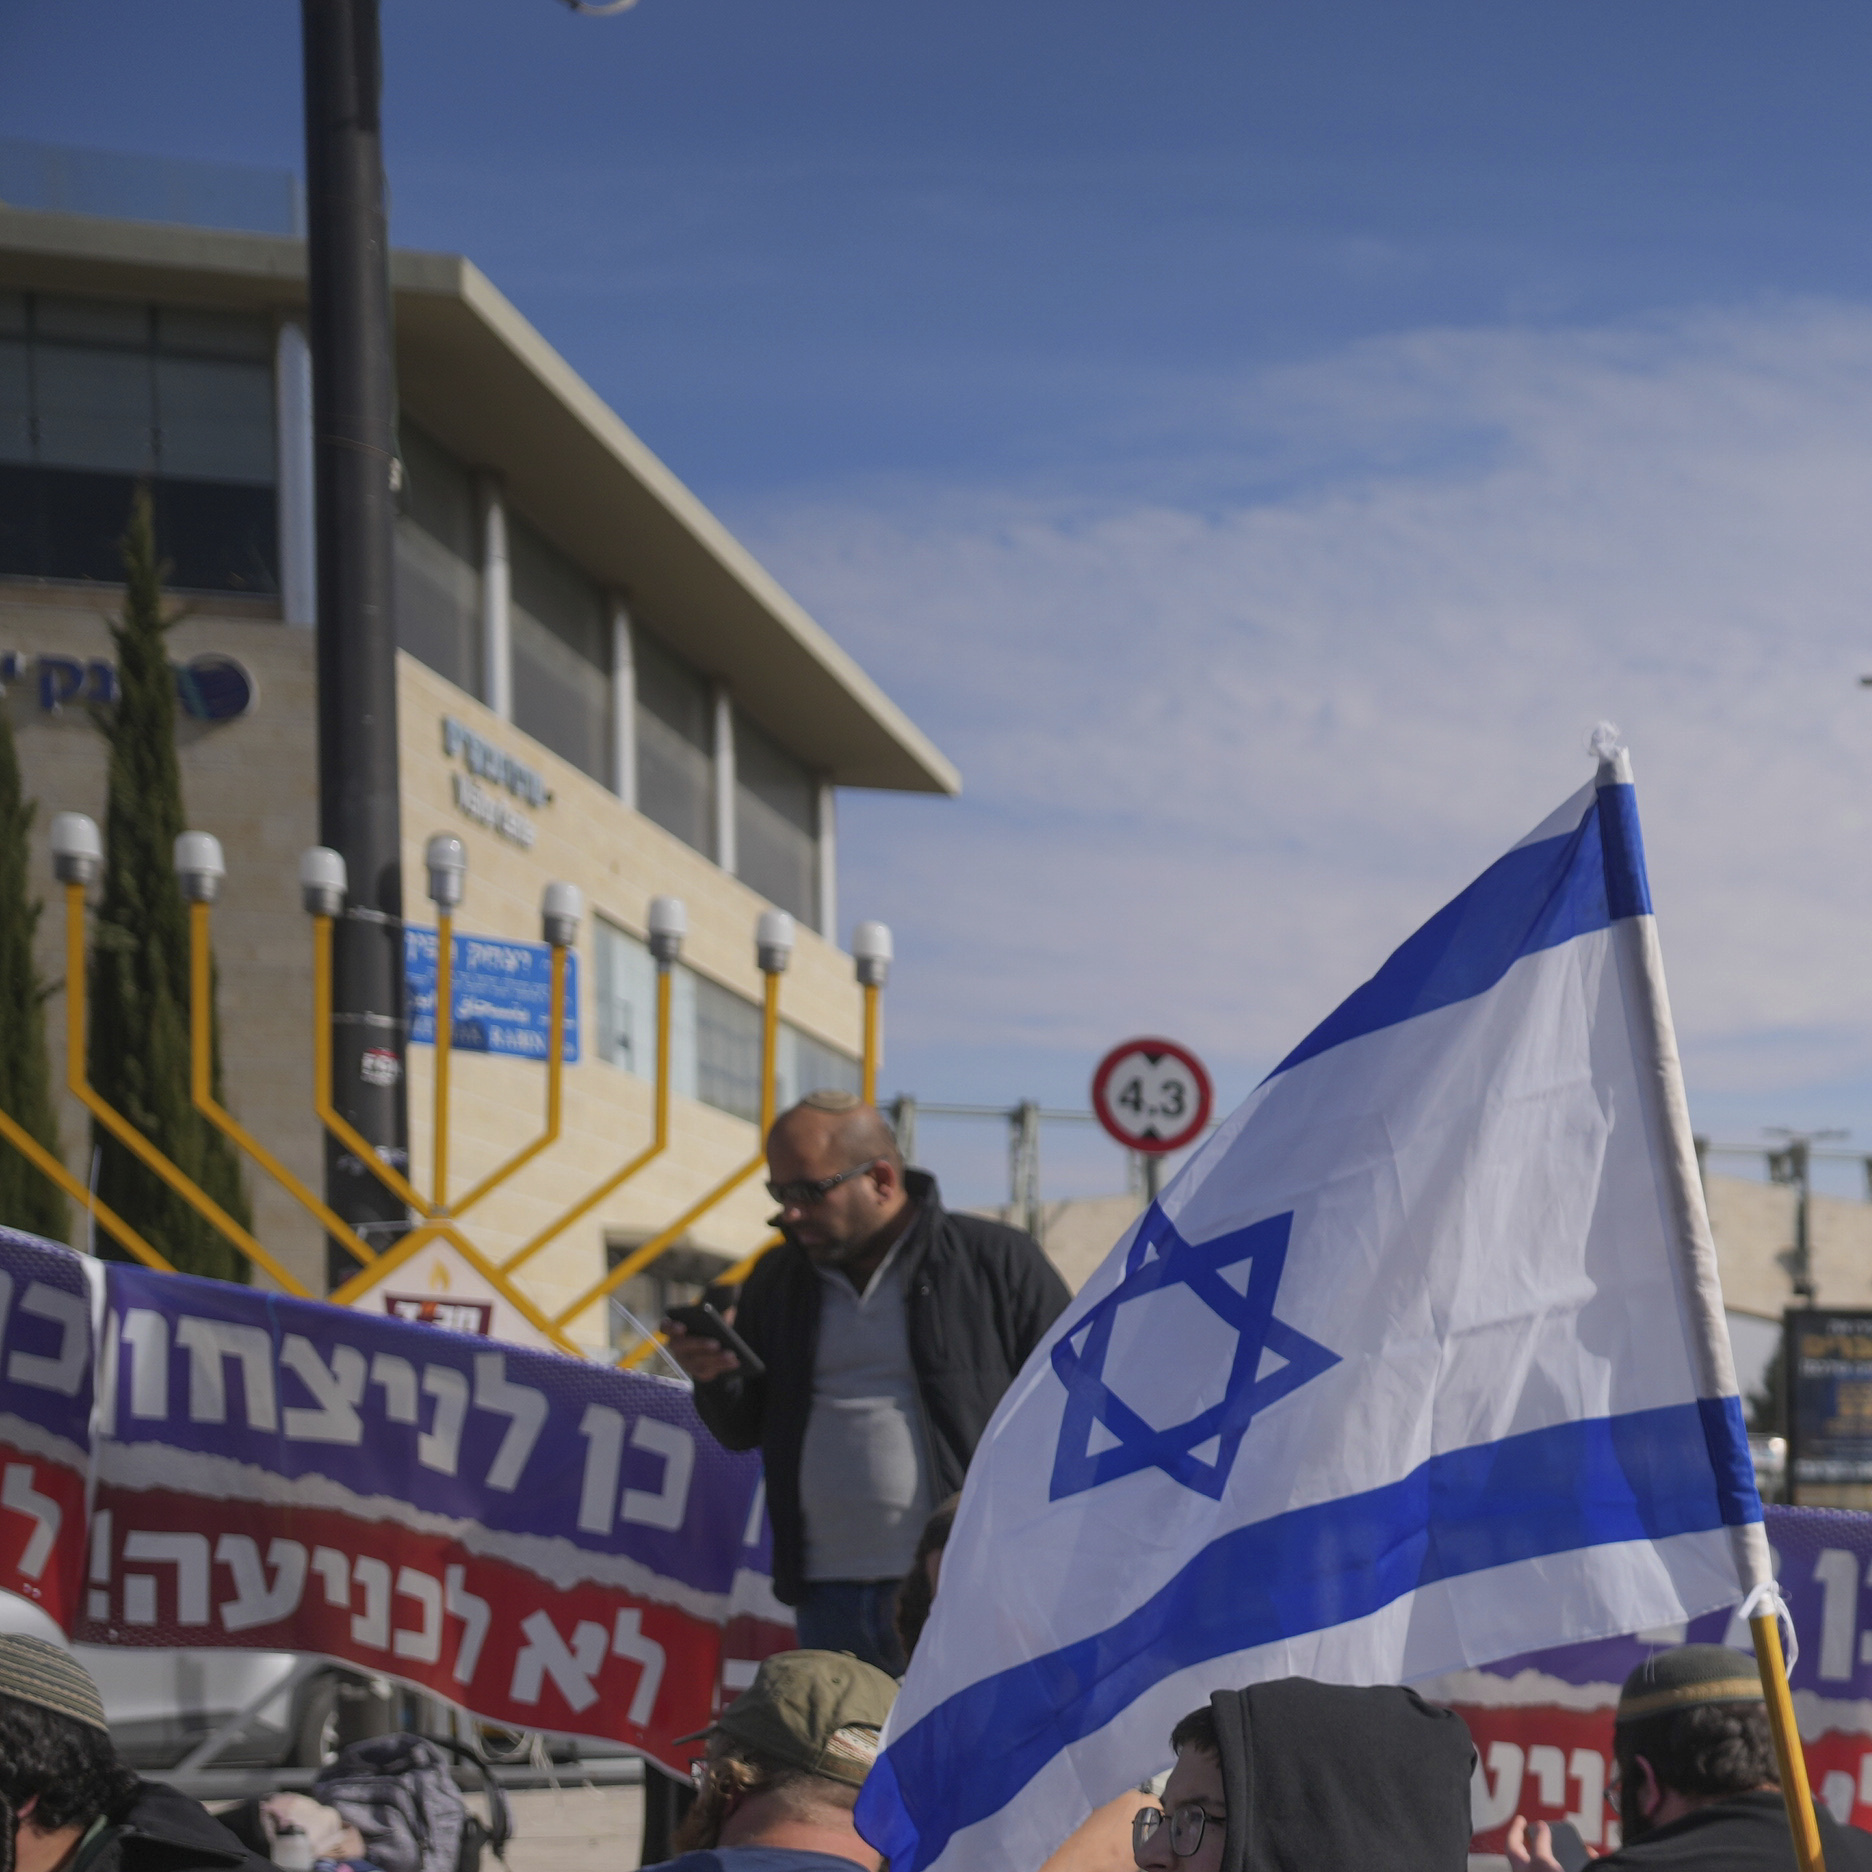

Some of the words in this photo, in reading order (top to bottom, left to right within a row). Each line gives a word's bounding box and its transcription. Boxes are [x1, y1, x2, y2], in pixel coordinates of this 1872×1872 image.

[1118, 1077, 1185, 1118] 4.3
[0, 1266, 90, 1396] כ
[577, 1402, 696, 1536] כן
[88, 1508, 491, 1686] לכניעה!
[510, 1606, 666, 1730] לא
